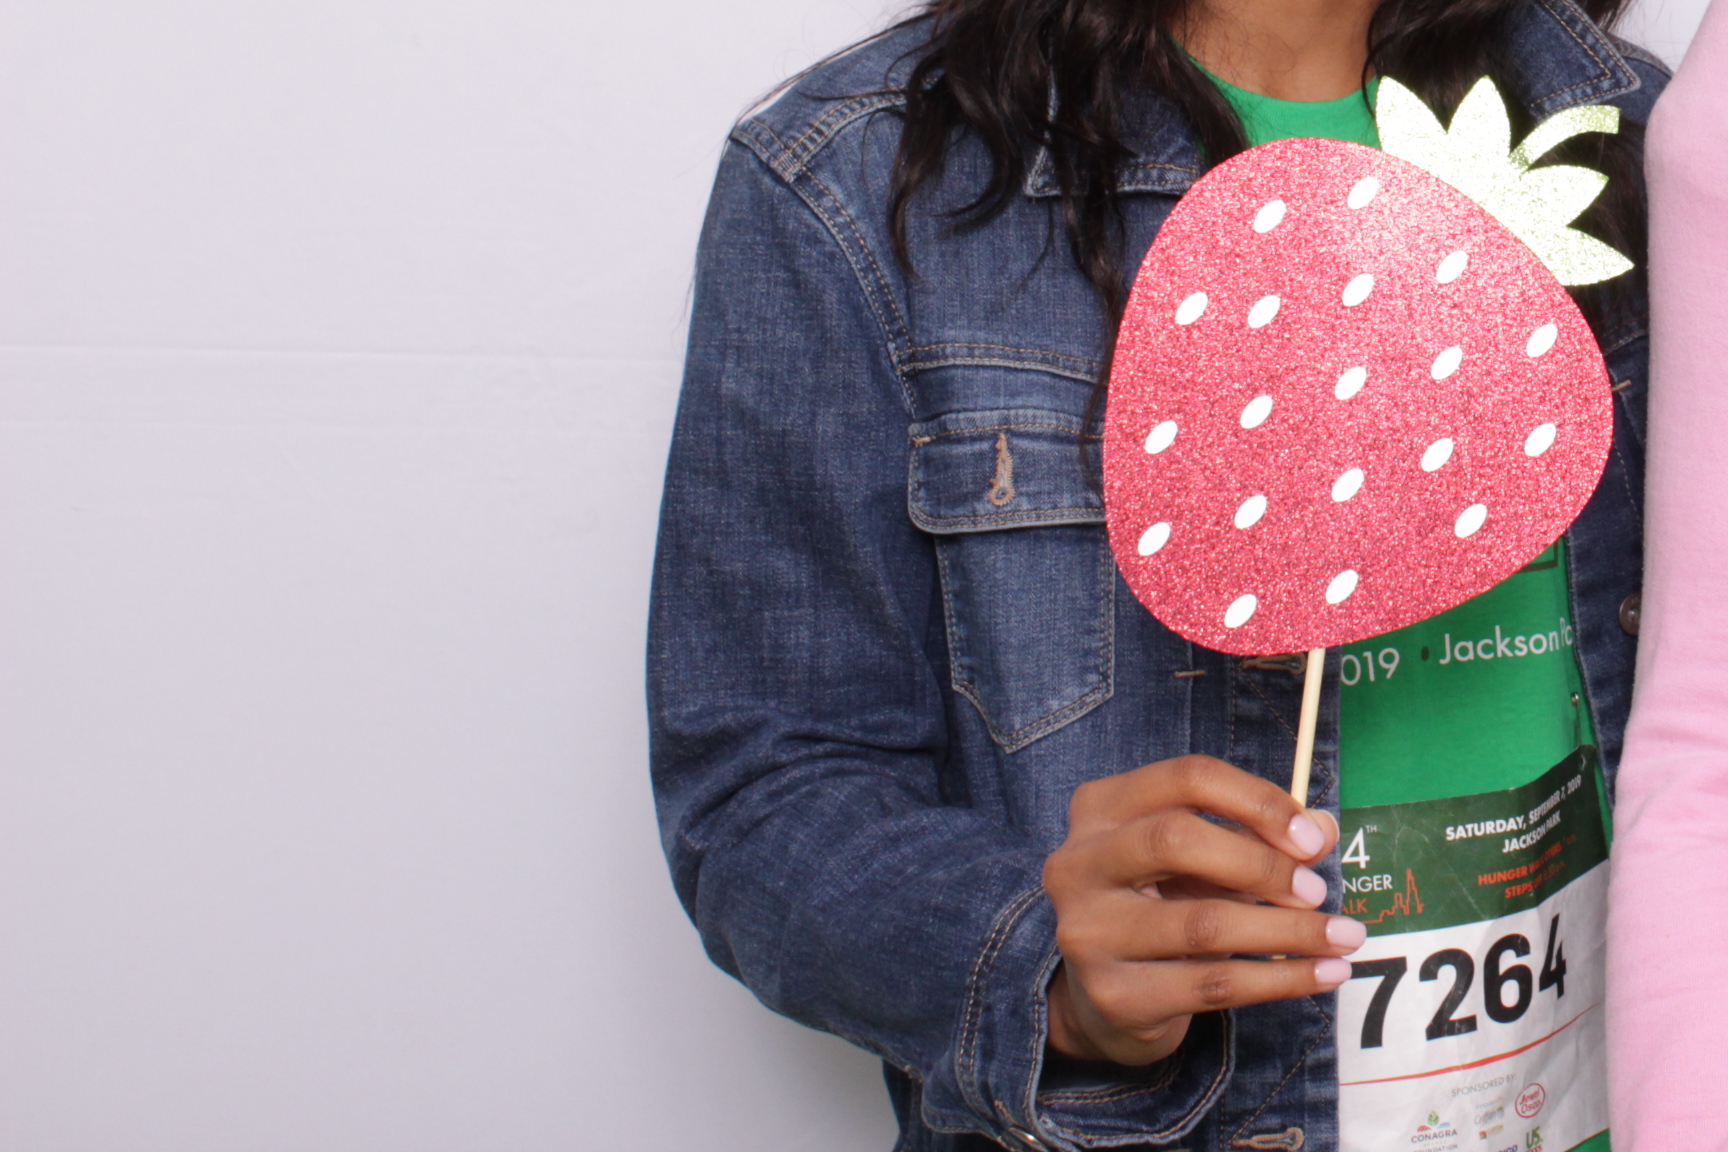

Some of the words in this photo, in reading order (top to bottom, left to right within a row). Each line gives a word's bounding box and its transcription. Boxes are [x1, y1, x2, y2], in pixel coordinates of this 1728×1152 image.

[1341, 647, 1400, 686] 019
[1438, 624, 1560, 665] Jackson
[1446, 815, 1527, 841] SATURDAY,
[1528, 790, 1561, 824] SEPTEMBER
[1567, 774, 1582, 795] 2019
[1502, 823, 1546, 854] JACKSON
[1342, 874, 1394, 894] NGER
[1477, 866, 1529, 886] HUNGER
[1504, 881, 1534, 899] STEPS
[1350, 913, 1567, 1050] 7264
[1451, 1077, 1505, 1098] SPONSORED
[1411, 1128, 1458, 1144] CONAGRA
